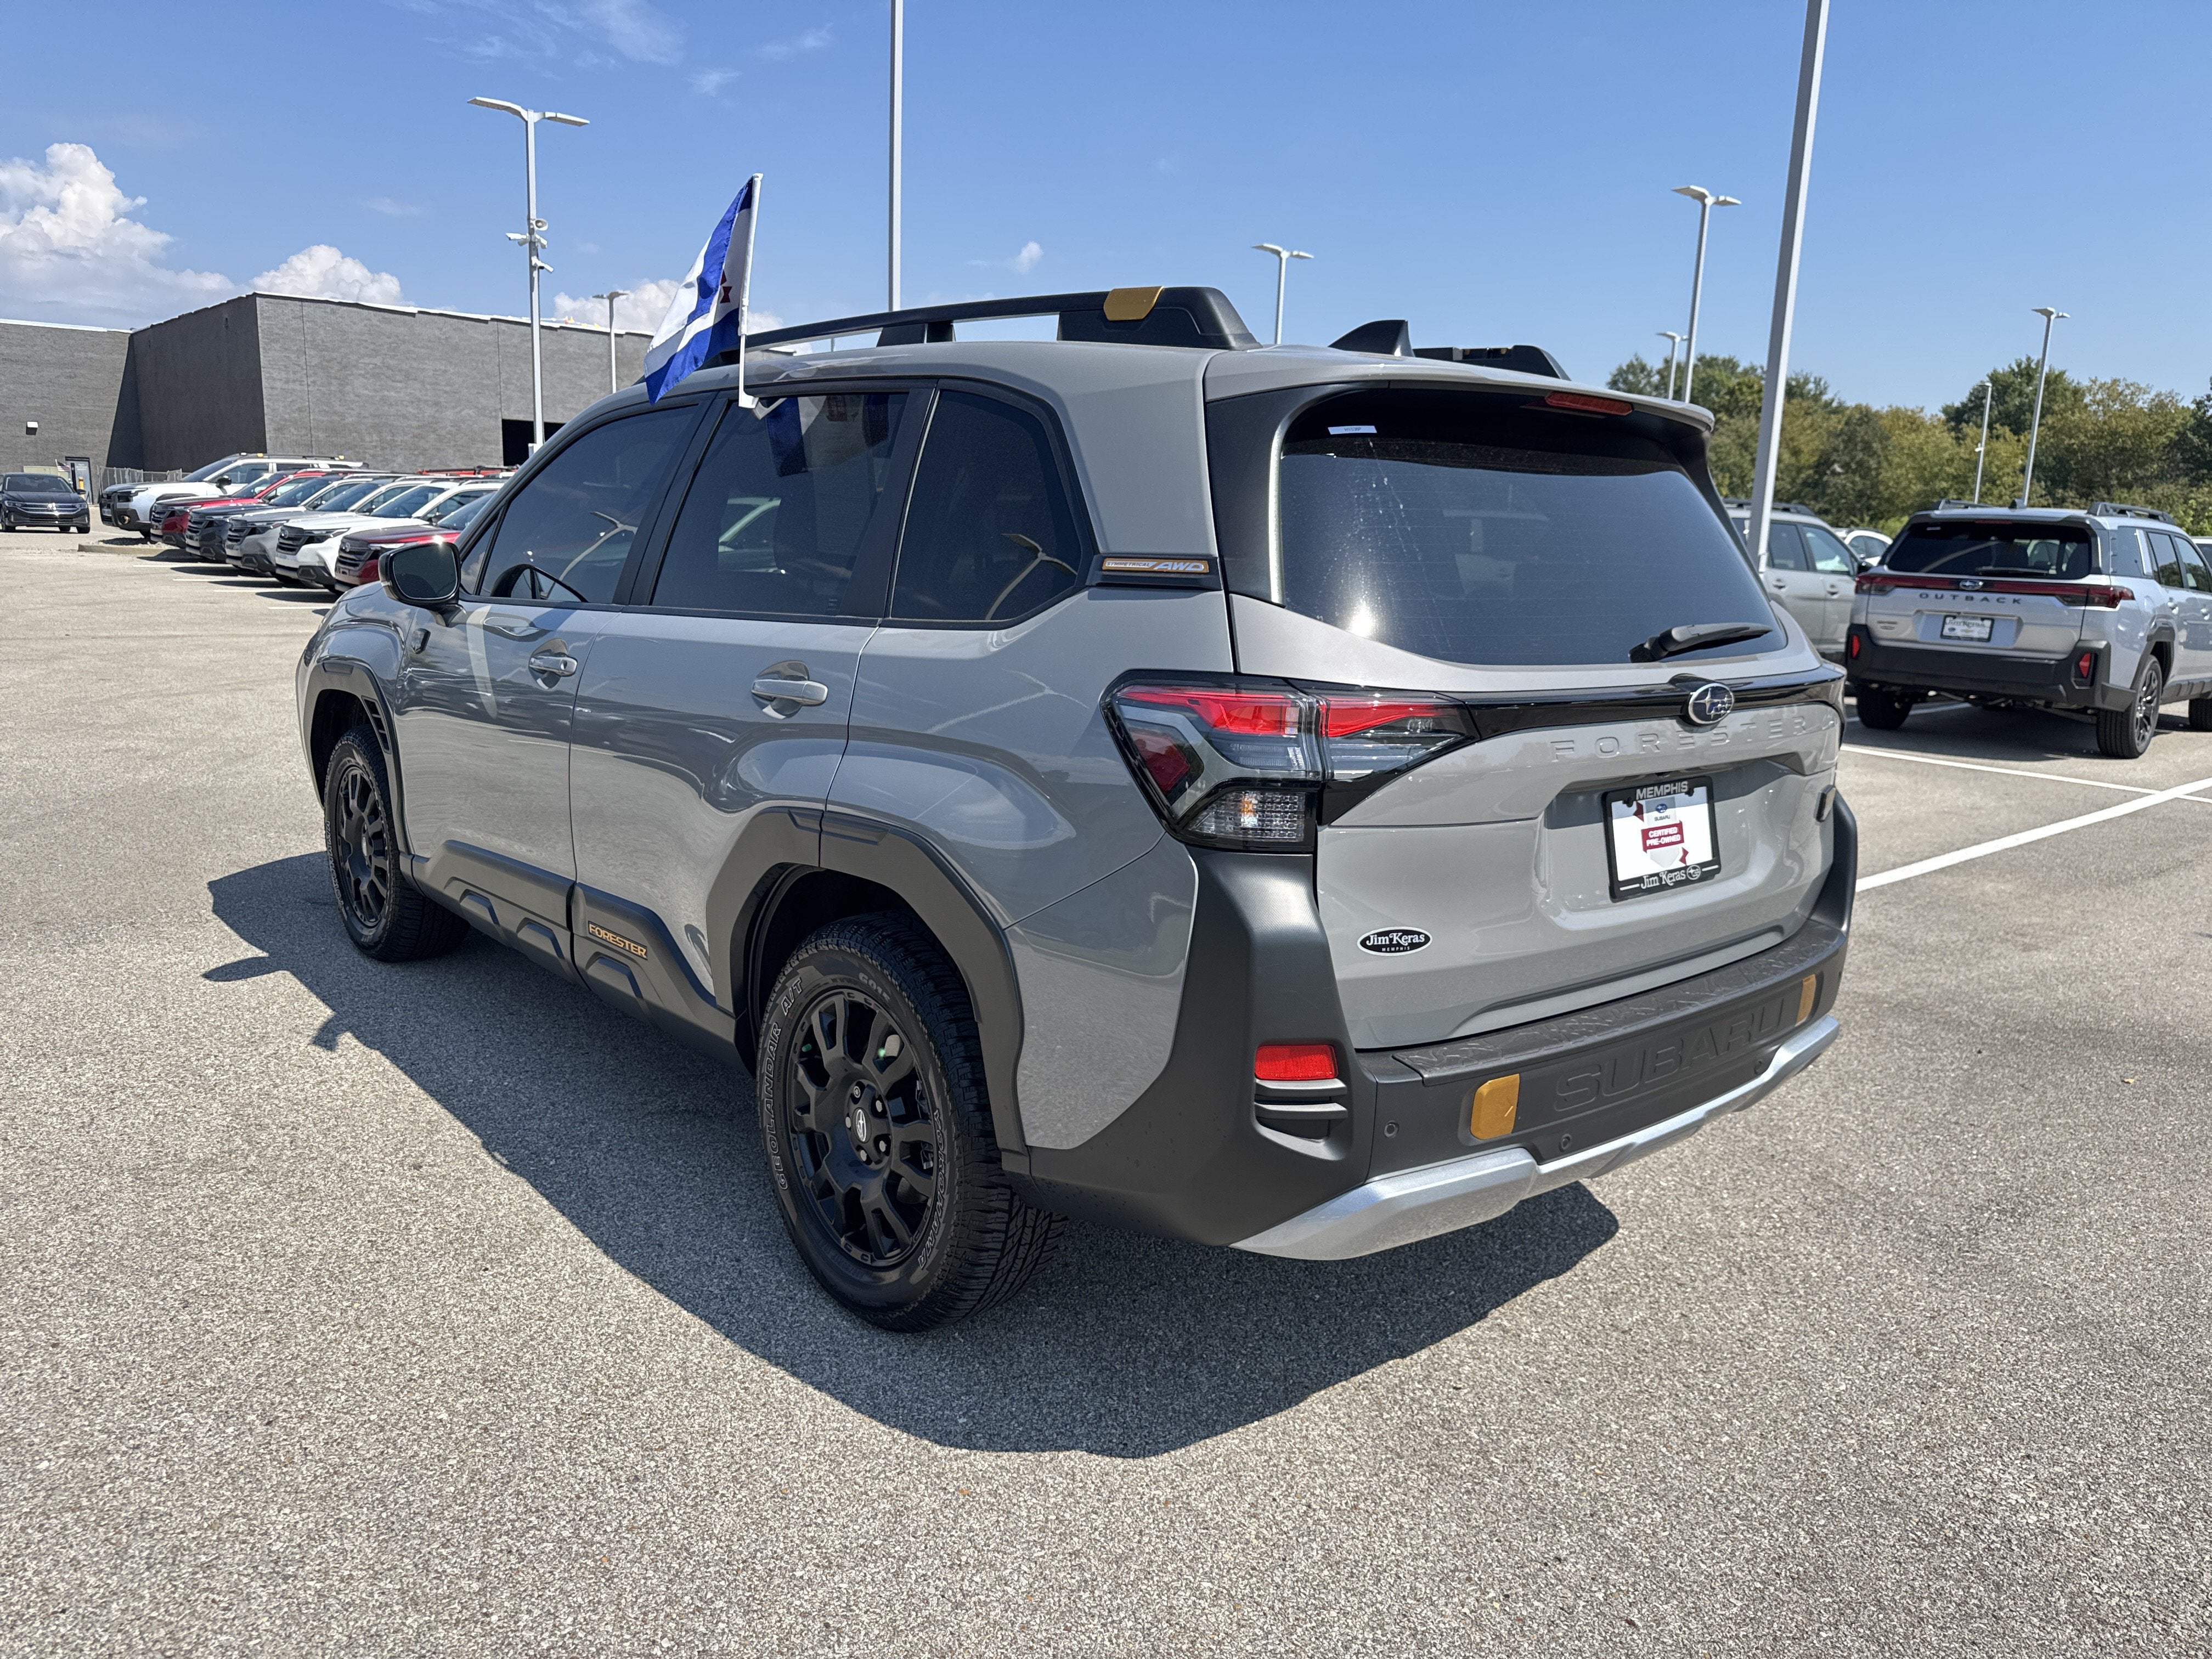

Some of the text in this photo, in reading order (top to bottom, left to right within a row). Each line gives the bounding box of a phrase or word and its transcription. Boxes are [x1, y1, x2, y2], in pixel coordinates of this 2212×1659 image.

[1153, 562, 1204, 571] AWD
[1919, 592, 2022, 604] OUTBACK
[1550, 716, 1809, 763] FORESTER
[1636, 781, 1689, 800] MEMPHIS
[1646, 834, 1681, 847] PRE-OWNED
[1649, 827, 1678, 838] CERTIFIED
[1640, 869, 1686, 889] Jim Keras
[589, 923, 647, 958] FORESTER
[1366, 933, 1425, 946] Jim Keras
[1555, 998, 1784, 1112] SUBARU
[764, 1022, 788, 1190] GEOLANDAR
[781, 977, 802, 1016] A/T
[918, 1109, 944, 1269] YOKOHAMA
